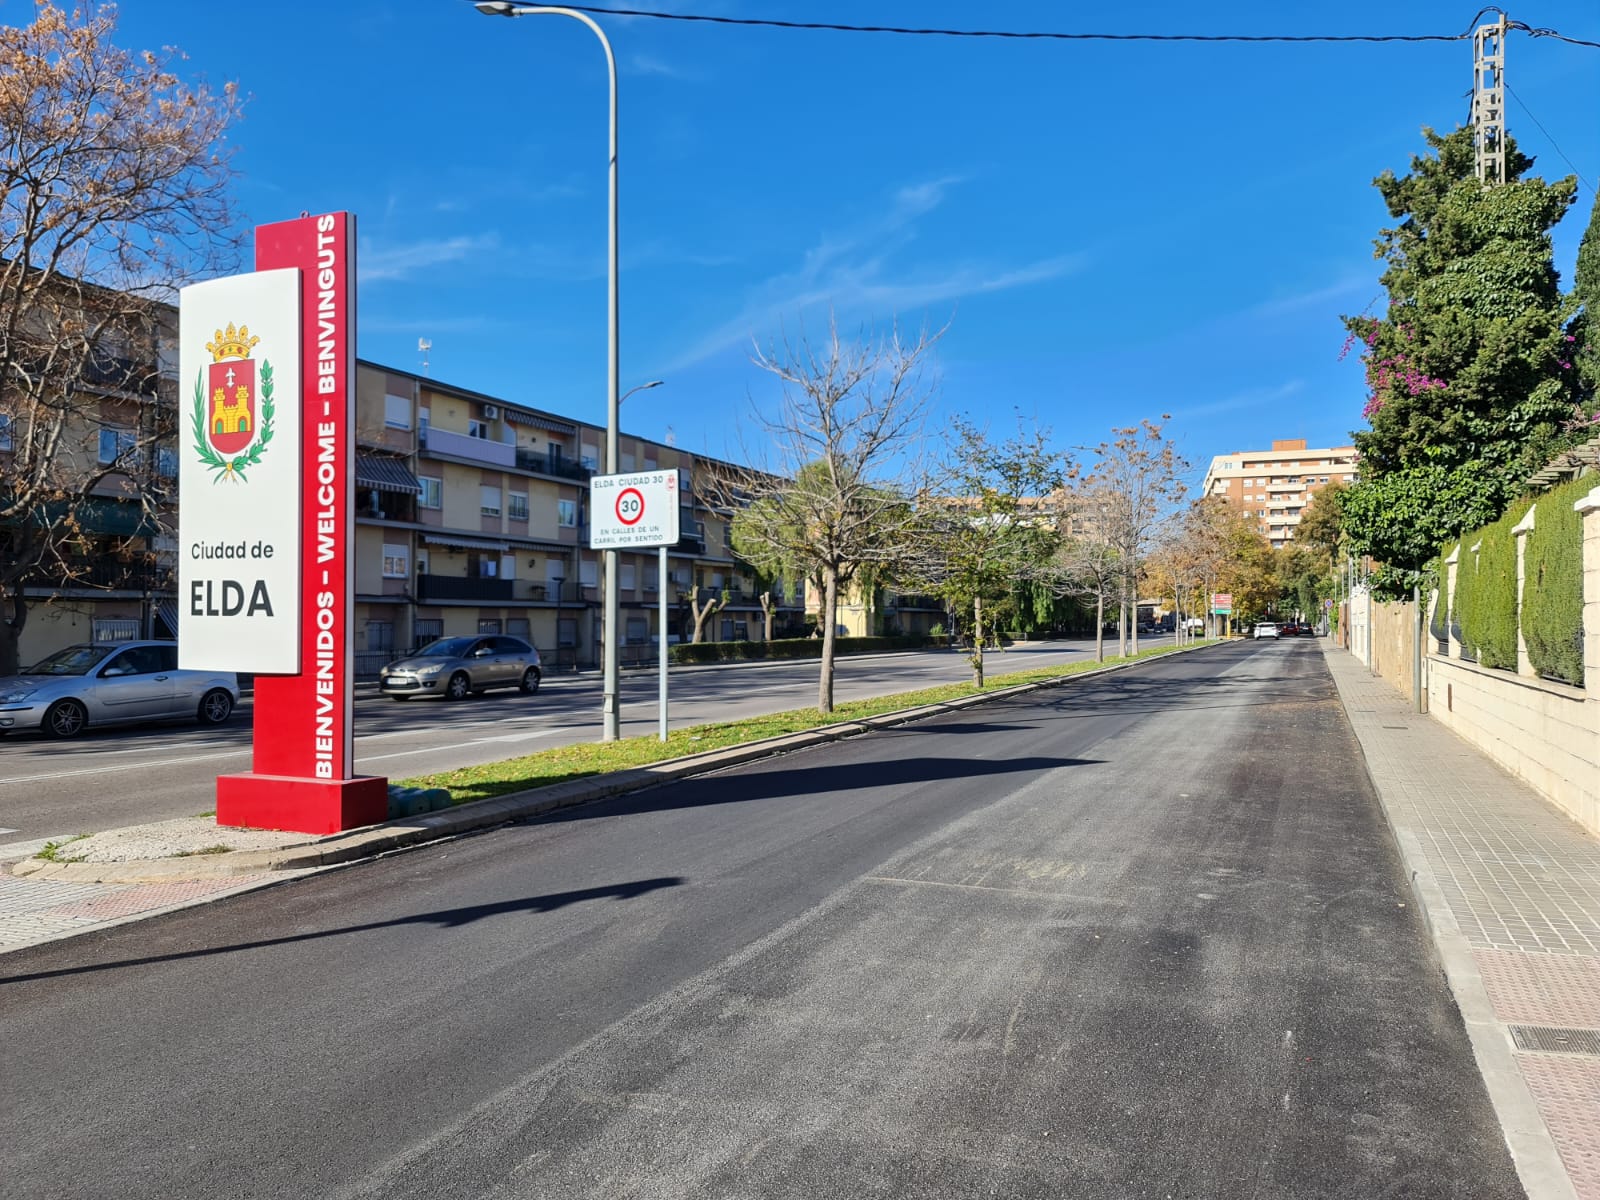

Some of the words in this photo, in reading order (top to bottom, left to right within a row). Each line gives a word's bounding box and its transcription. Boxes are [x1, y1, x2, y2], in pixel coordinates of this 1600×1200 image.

[317, 214, 335, 395] BENVINGUTS
[317, 421, 336, 563] WELCOME
[594, 480, 615, 489] ELDA
[618, 476, 650, 487] CIUDAD
[652, 475, 664, 484] 30
[621, 499, 639, 513] 30
[612, 527, 635, 535] CALLES
[635, 534, 664, 542] SENTIDO
[191, 540, 246, 560] Ciudad
[251, 540, 274, 559] de
[191, 579, 274, 617] ELDA
[315, 591, 334, 779] BIENVENIDOS
